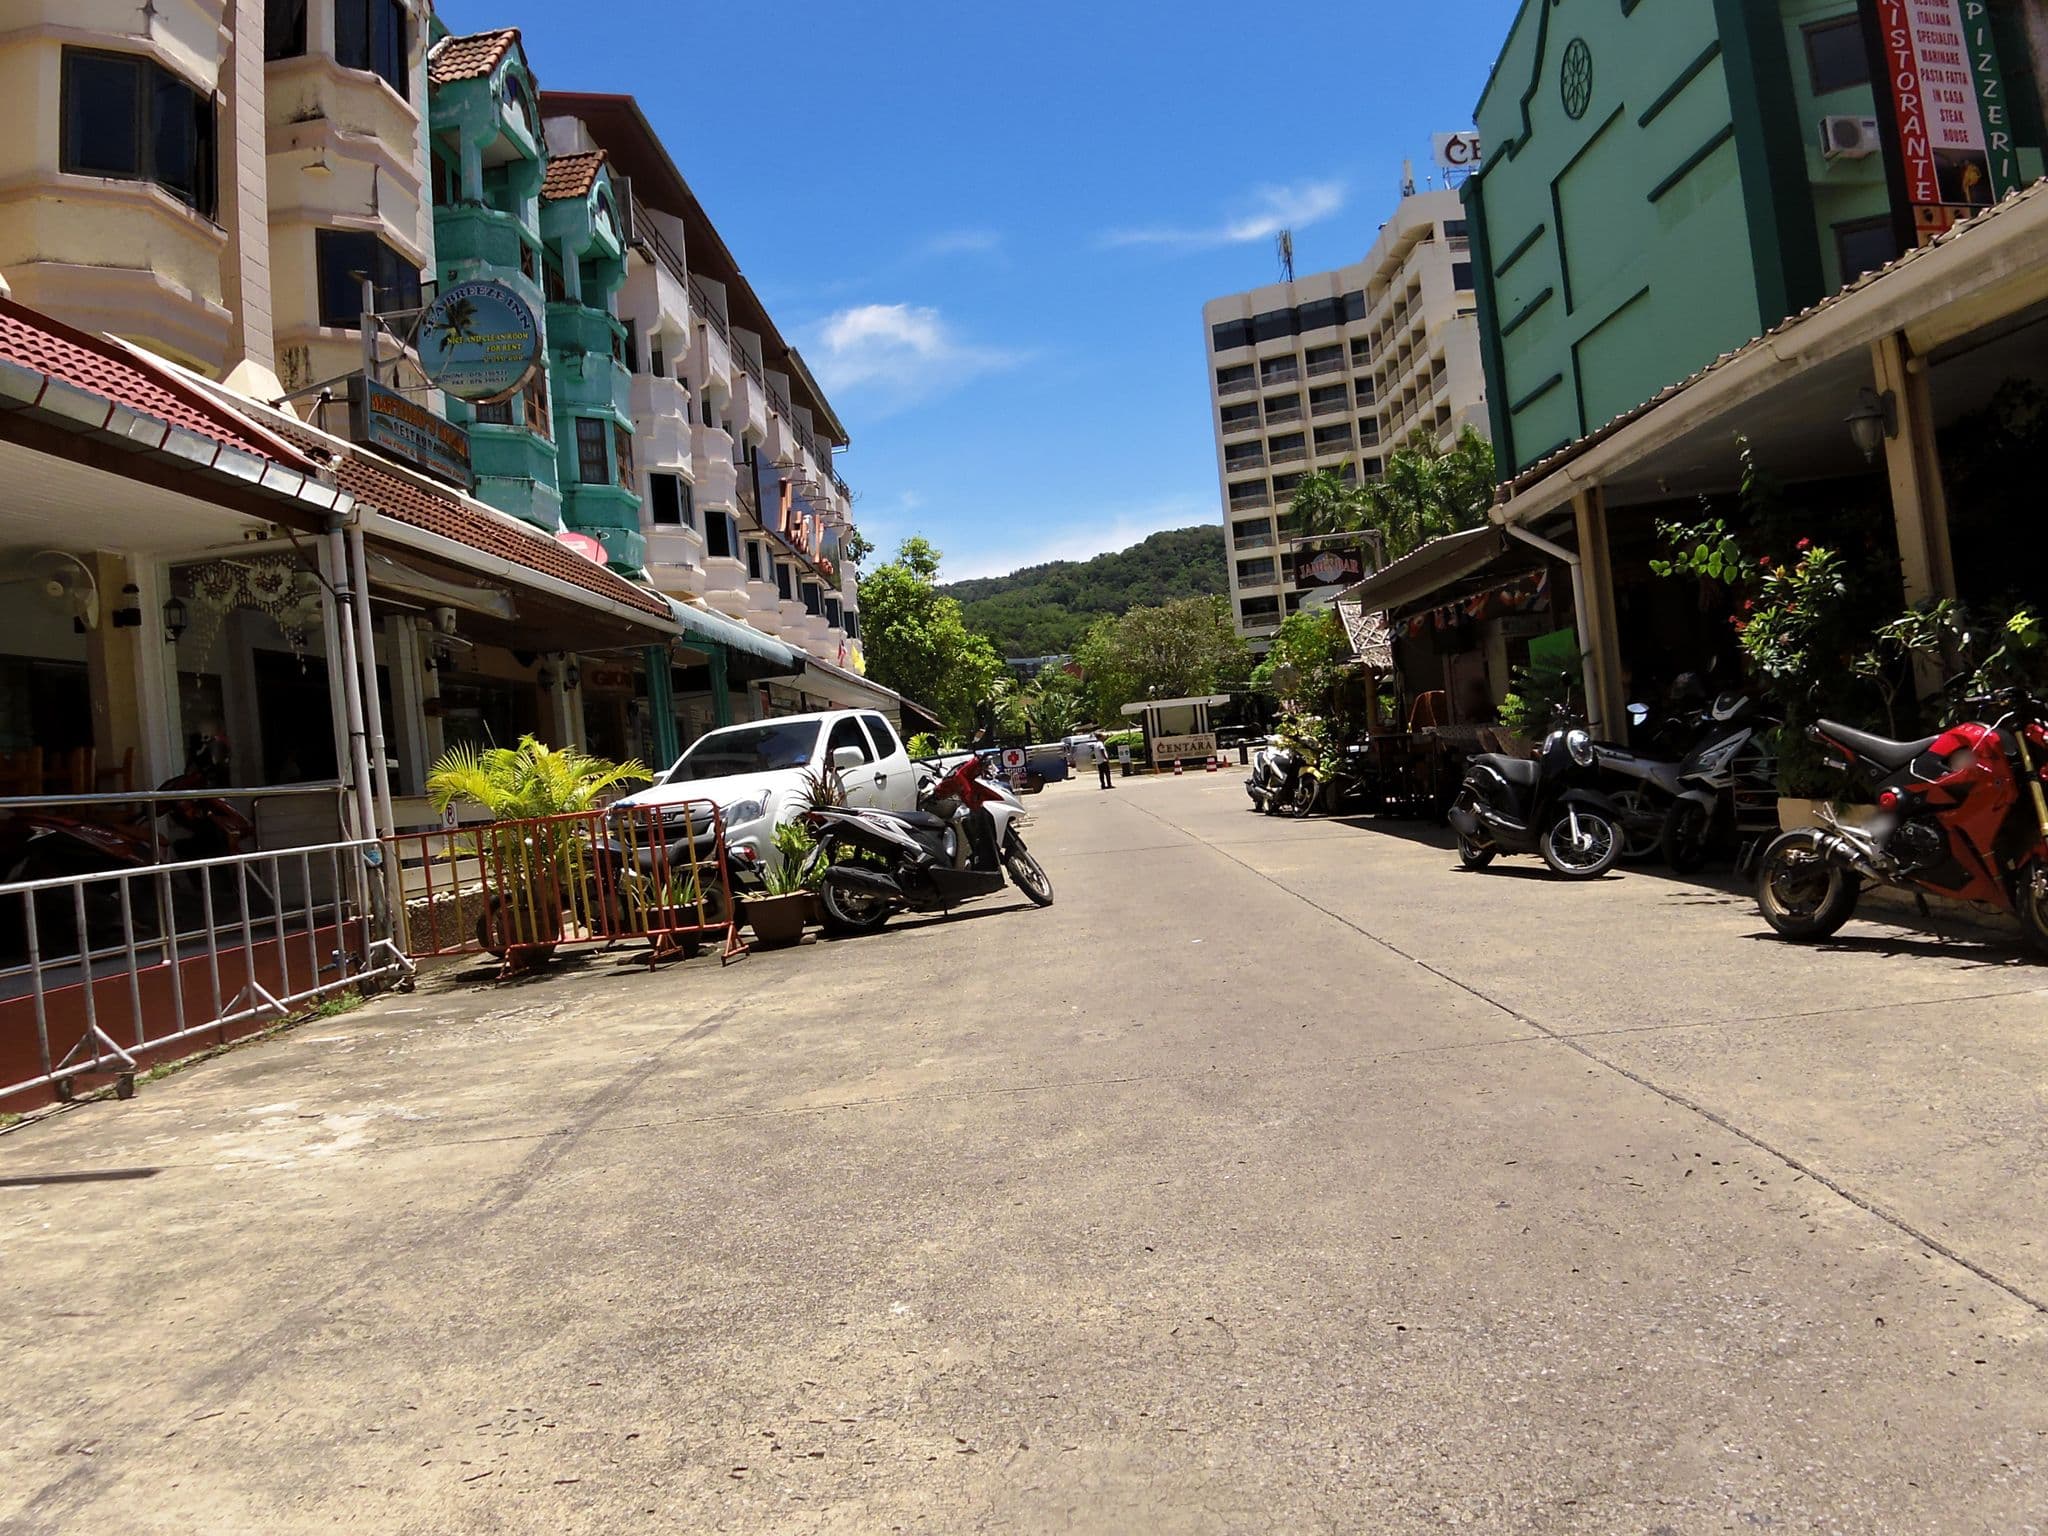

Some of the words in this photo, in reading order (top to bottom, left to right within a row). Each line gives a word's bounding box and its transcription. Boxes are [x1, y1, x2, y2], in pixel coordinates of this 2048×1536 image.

[1917, 11, 1951, 26] ITALIANA
[1920, 49, 1961, 66] MARINARE
[1920, 68, 1944, 83] PASTA
[1945, 71, 1969, 85] FATTA
[1932, 89, 1942, 102] IN
[1943, 90, 1965, 104] CASA
[1940, 109, 1965, 123] STEAK
[1943, 129, 1969, 143] HOUSE
[423, 305, 445, 337] SEA
[445, 286, 506, 305] BREEZE
[506, 297, 531, 331] INN
[466, 335, 481, 344] AND
[1157, 741, 1212, 753] CENTARA
